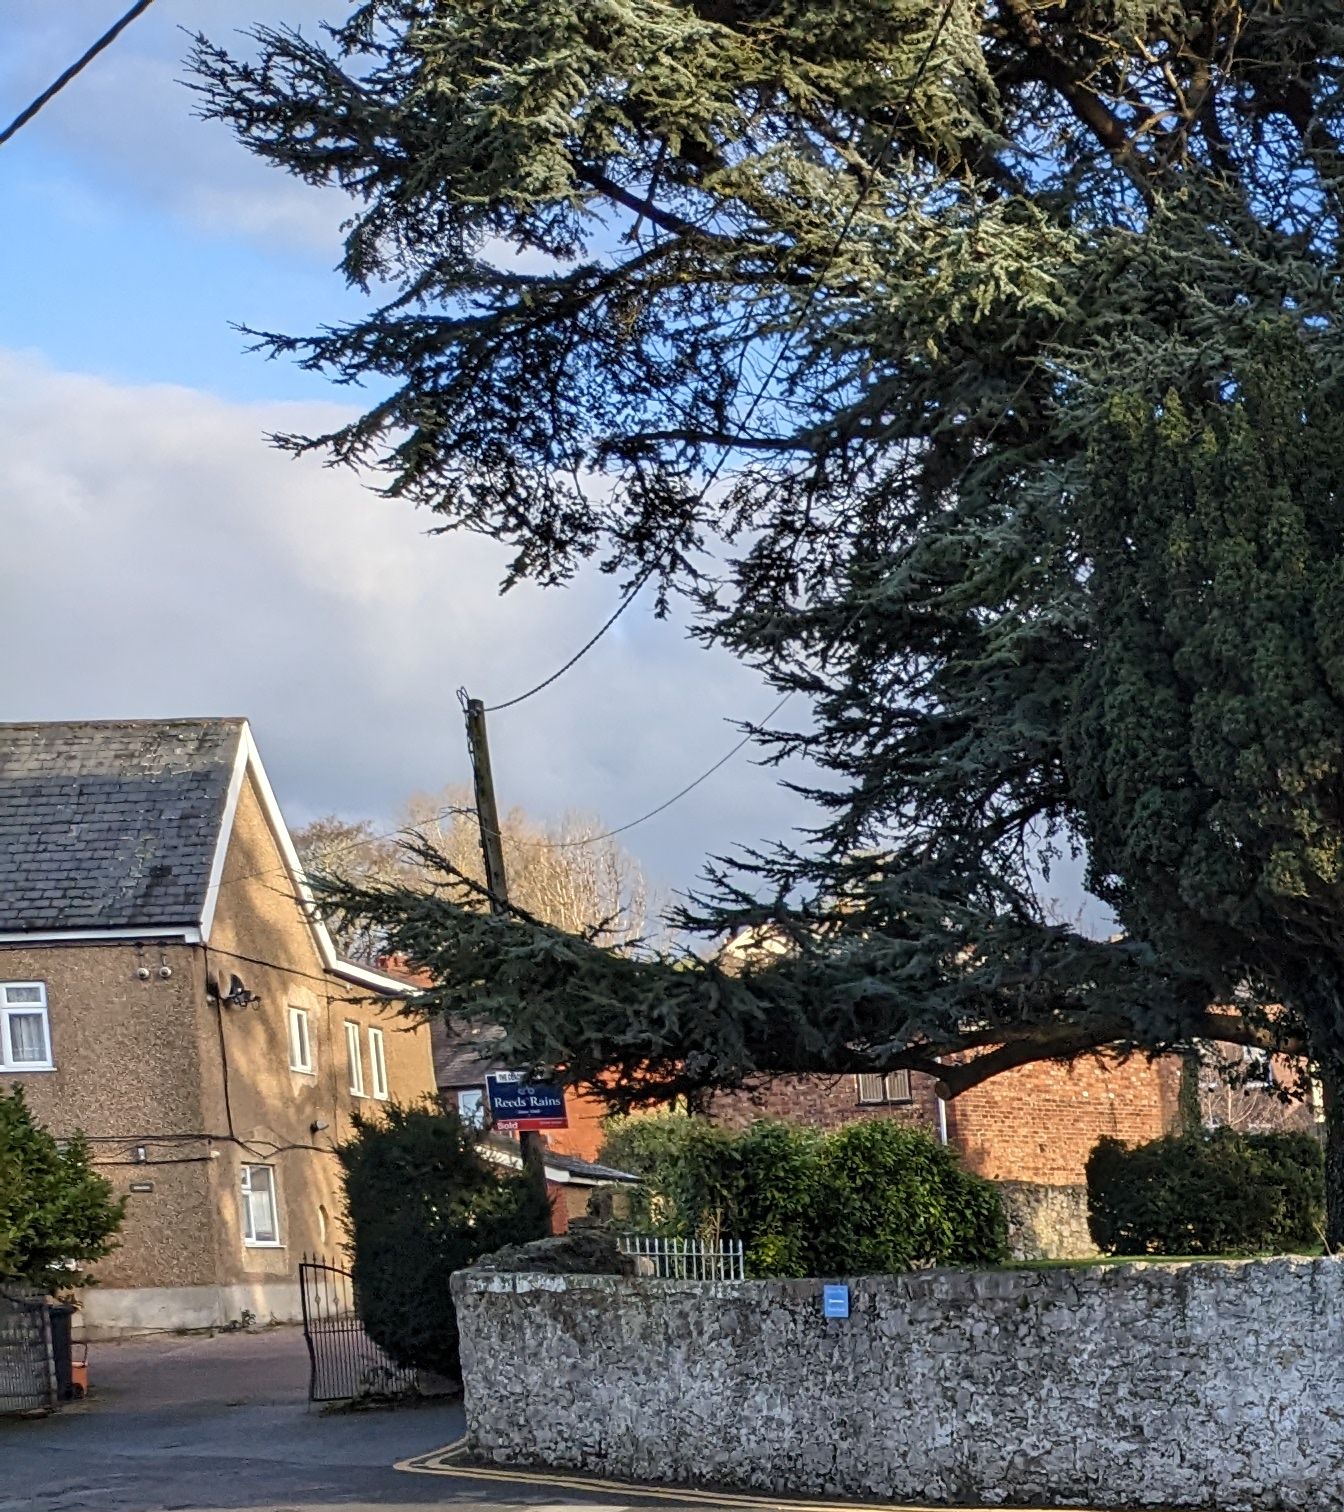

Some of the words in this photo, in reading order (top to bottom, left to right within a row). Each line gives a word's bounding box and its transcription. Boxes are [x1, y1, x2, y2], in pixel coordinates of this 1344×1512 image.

[494, 1097, 527, 1108] Reeds
[530, 1096, 561, 1107] Rains
[497, 1121, 518, 1130] Sold
